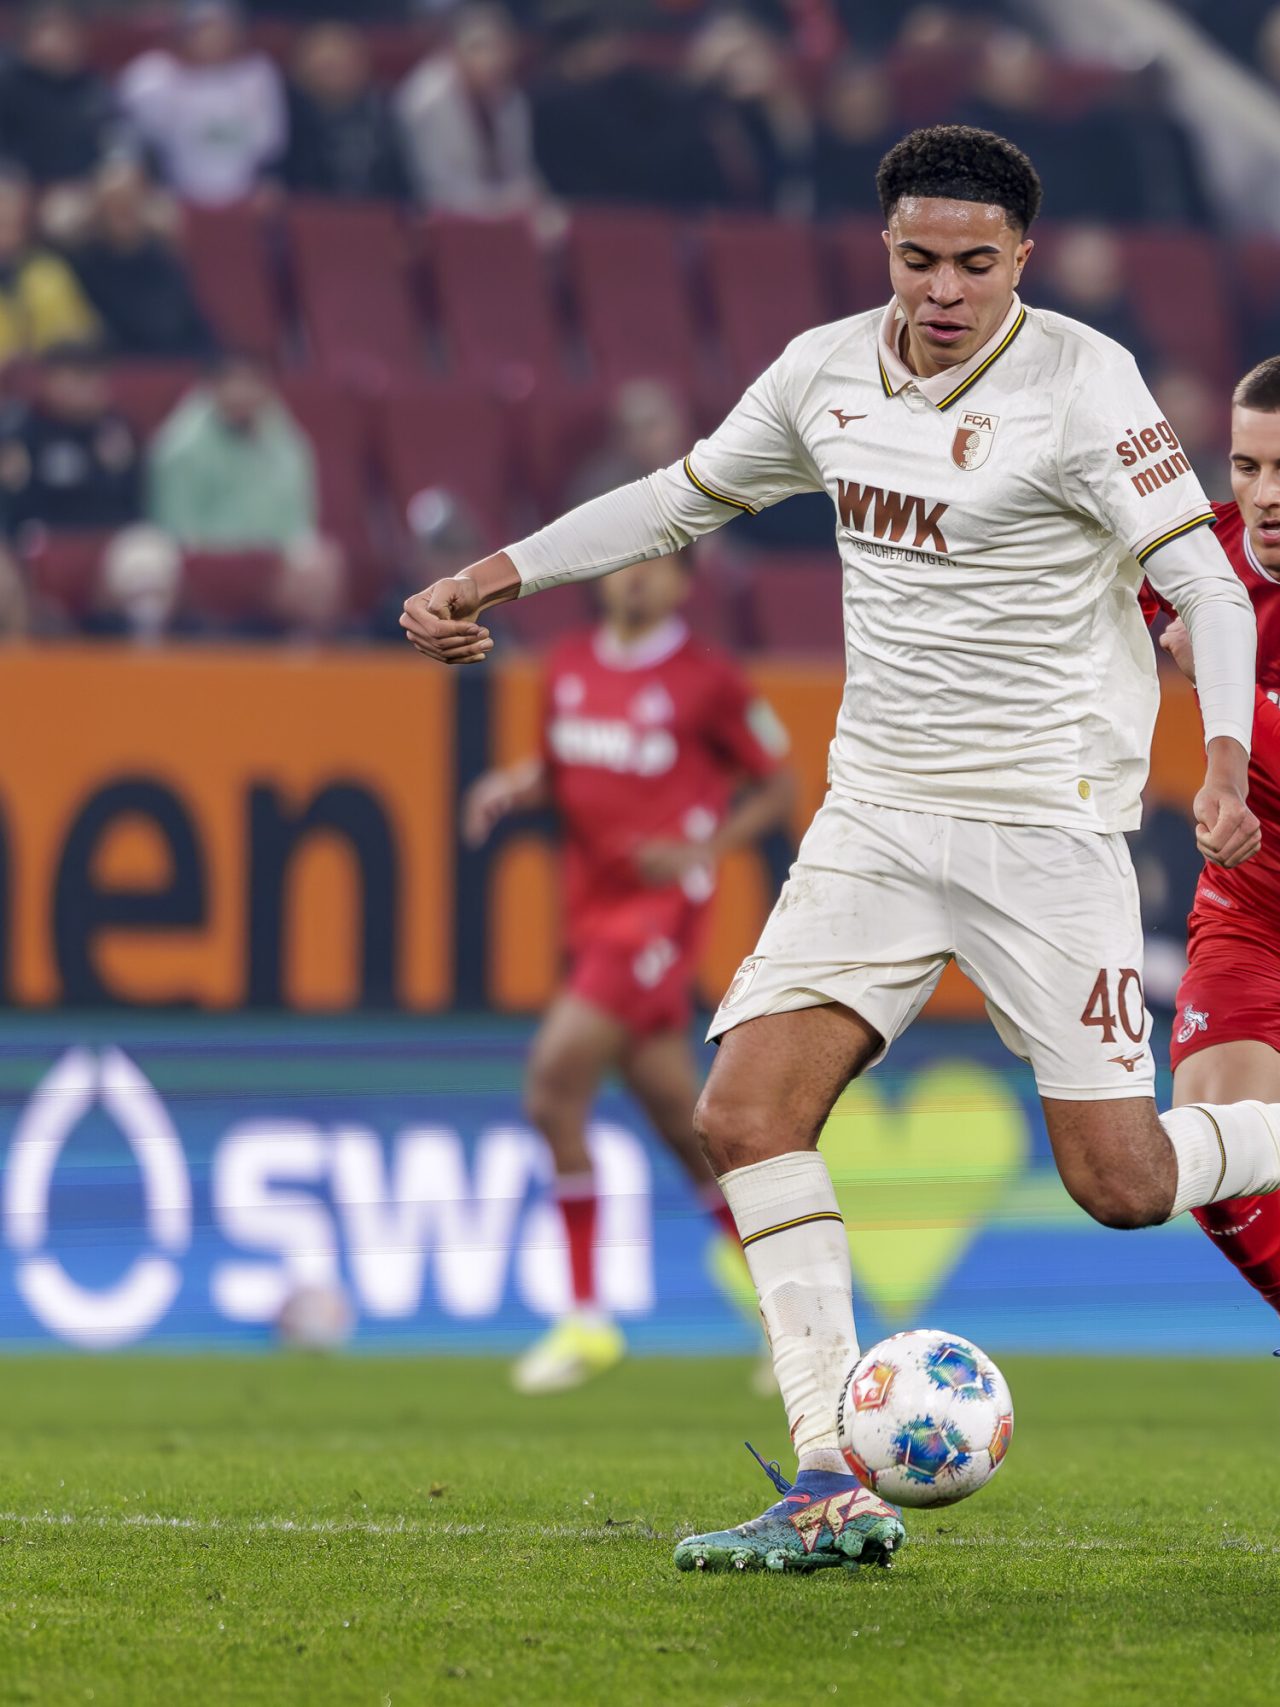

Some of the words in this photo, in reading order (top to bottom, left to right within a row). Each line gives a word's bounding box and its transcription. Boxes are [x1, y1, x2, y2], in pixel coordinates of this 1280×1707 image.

[963, 414, 992, 431] FCA
[1116, 420, 1179, 467] sieg
[836, 477, 950, 554] WWK
[1080, 968, 1146, 1044] 40
[210, 1116, 656, 1324] swa
